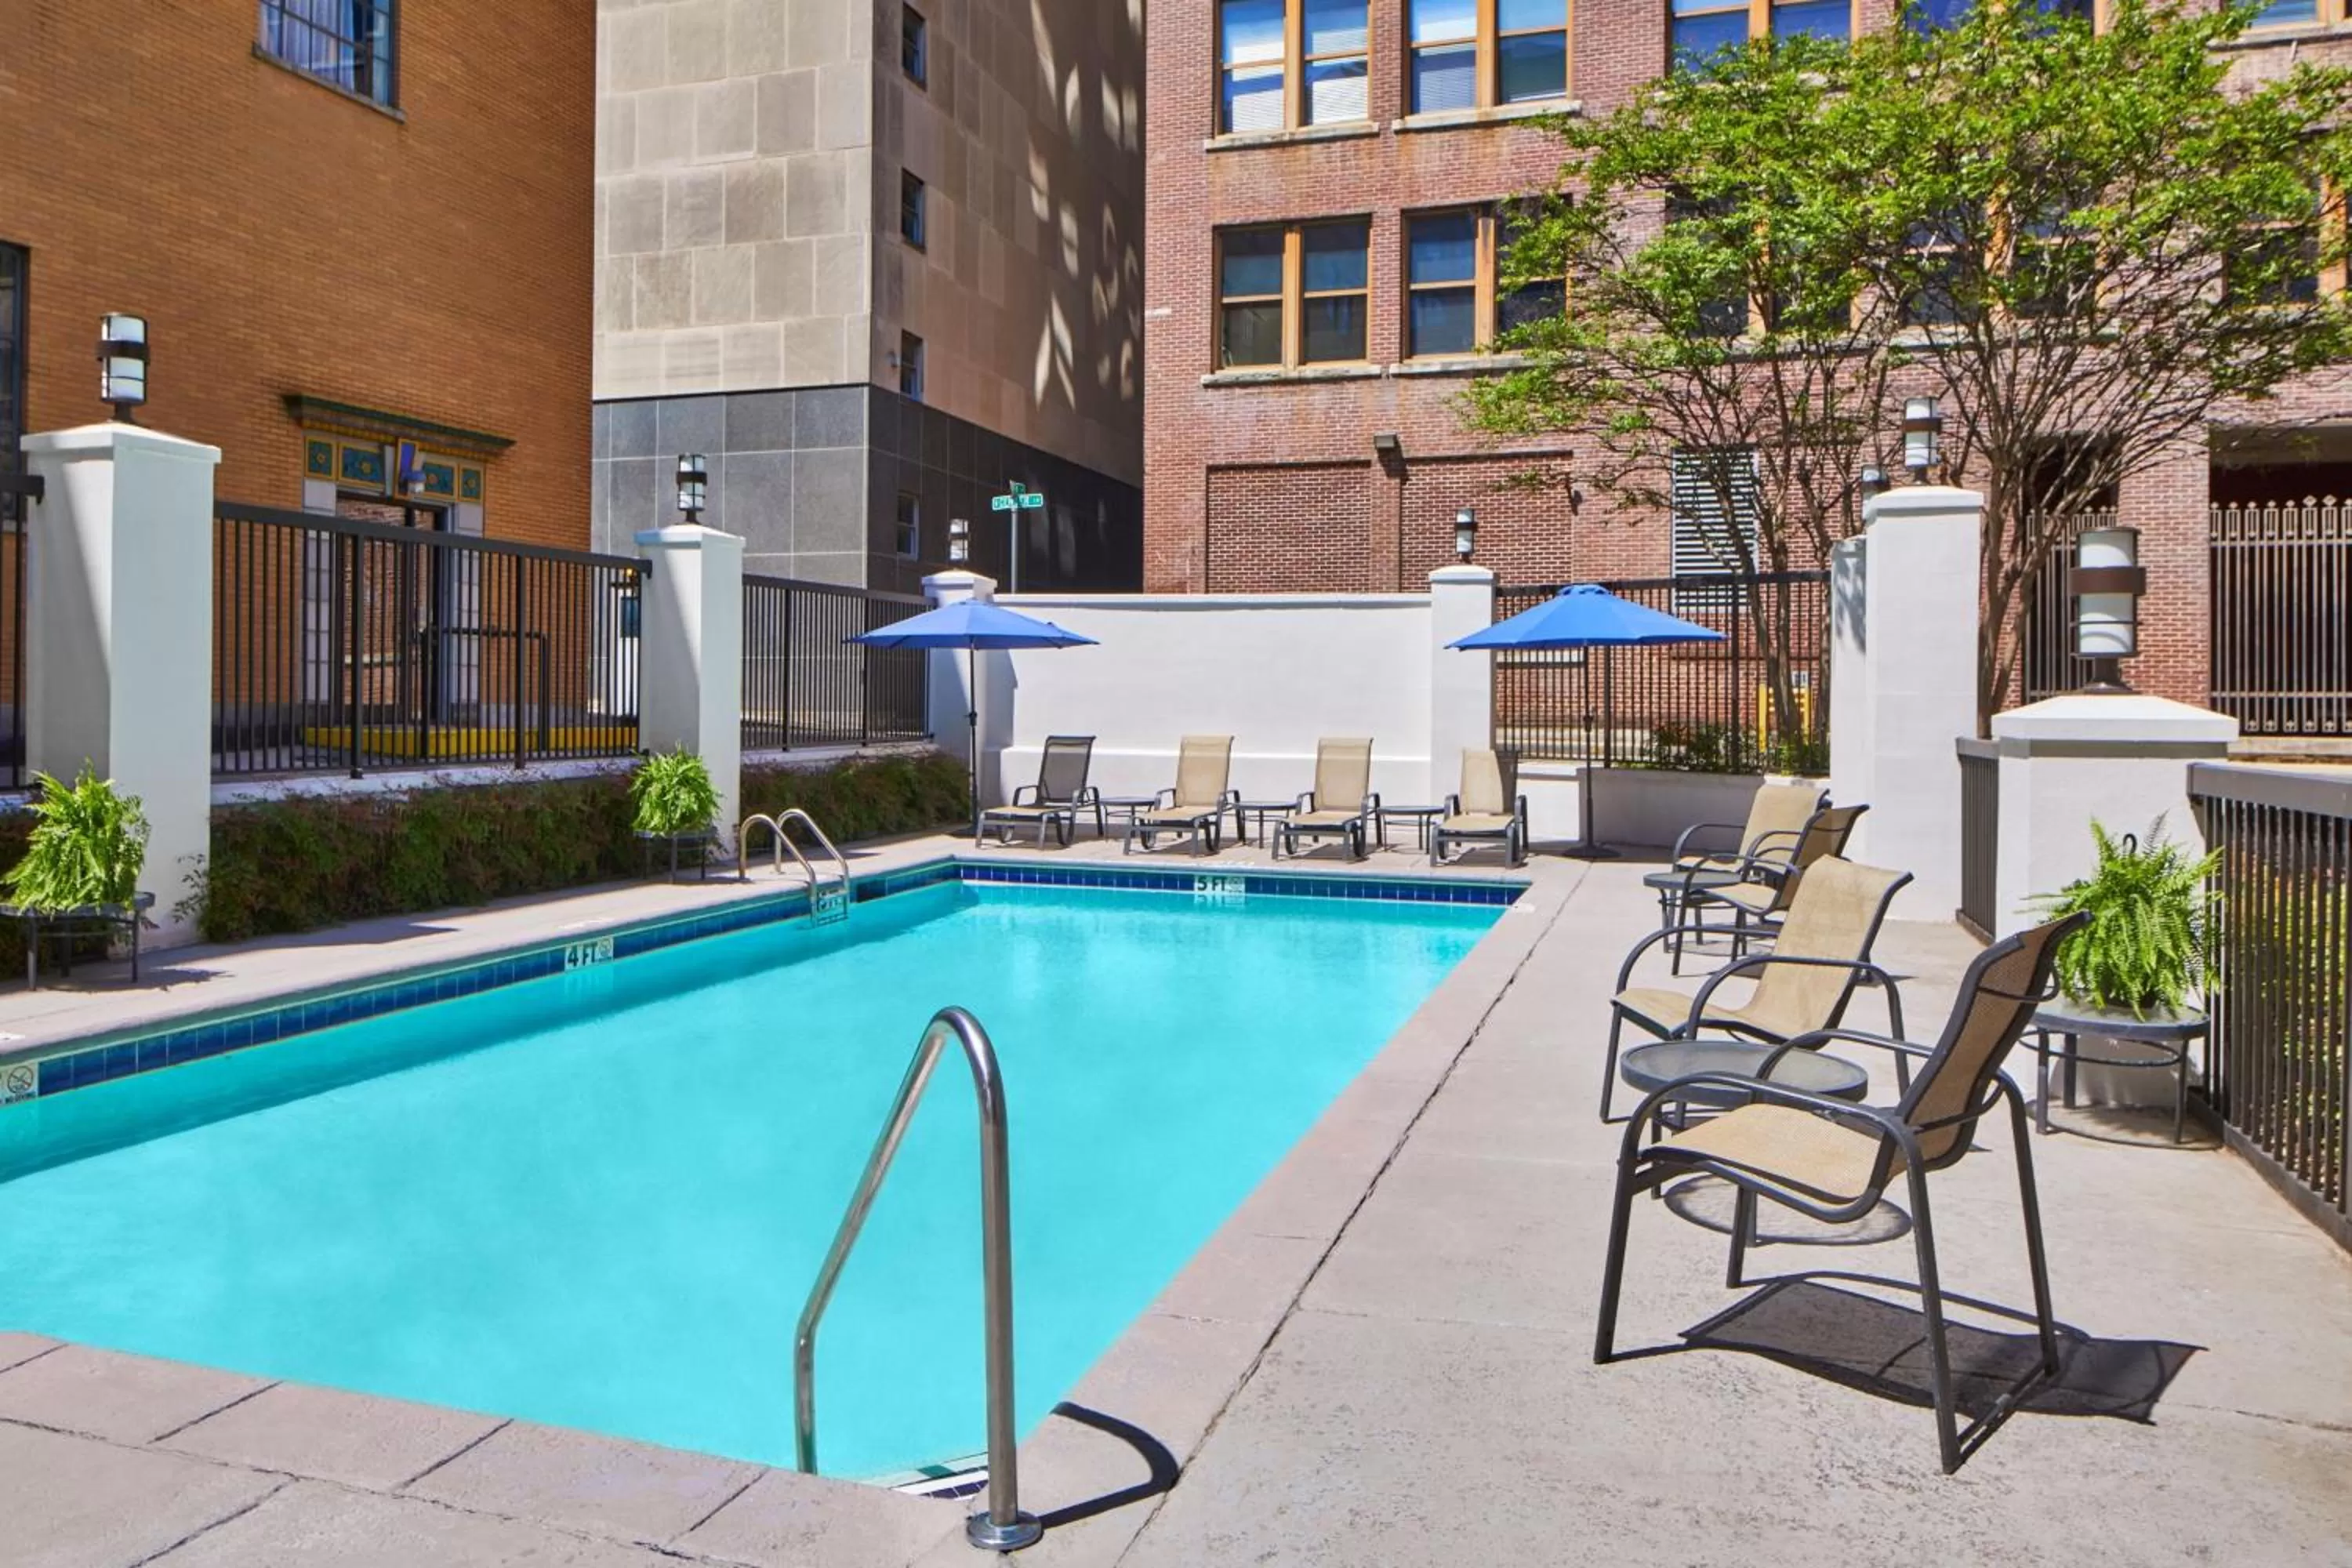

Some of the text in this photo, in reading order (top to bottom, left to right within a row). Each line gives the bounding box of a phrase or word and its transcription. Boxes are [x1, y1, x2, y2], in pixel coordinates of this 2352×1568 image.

[1198, 875, 1226, 891] 5 FT
[568, 942, 597, 967] 4 FT
